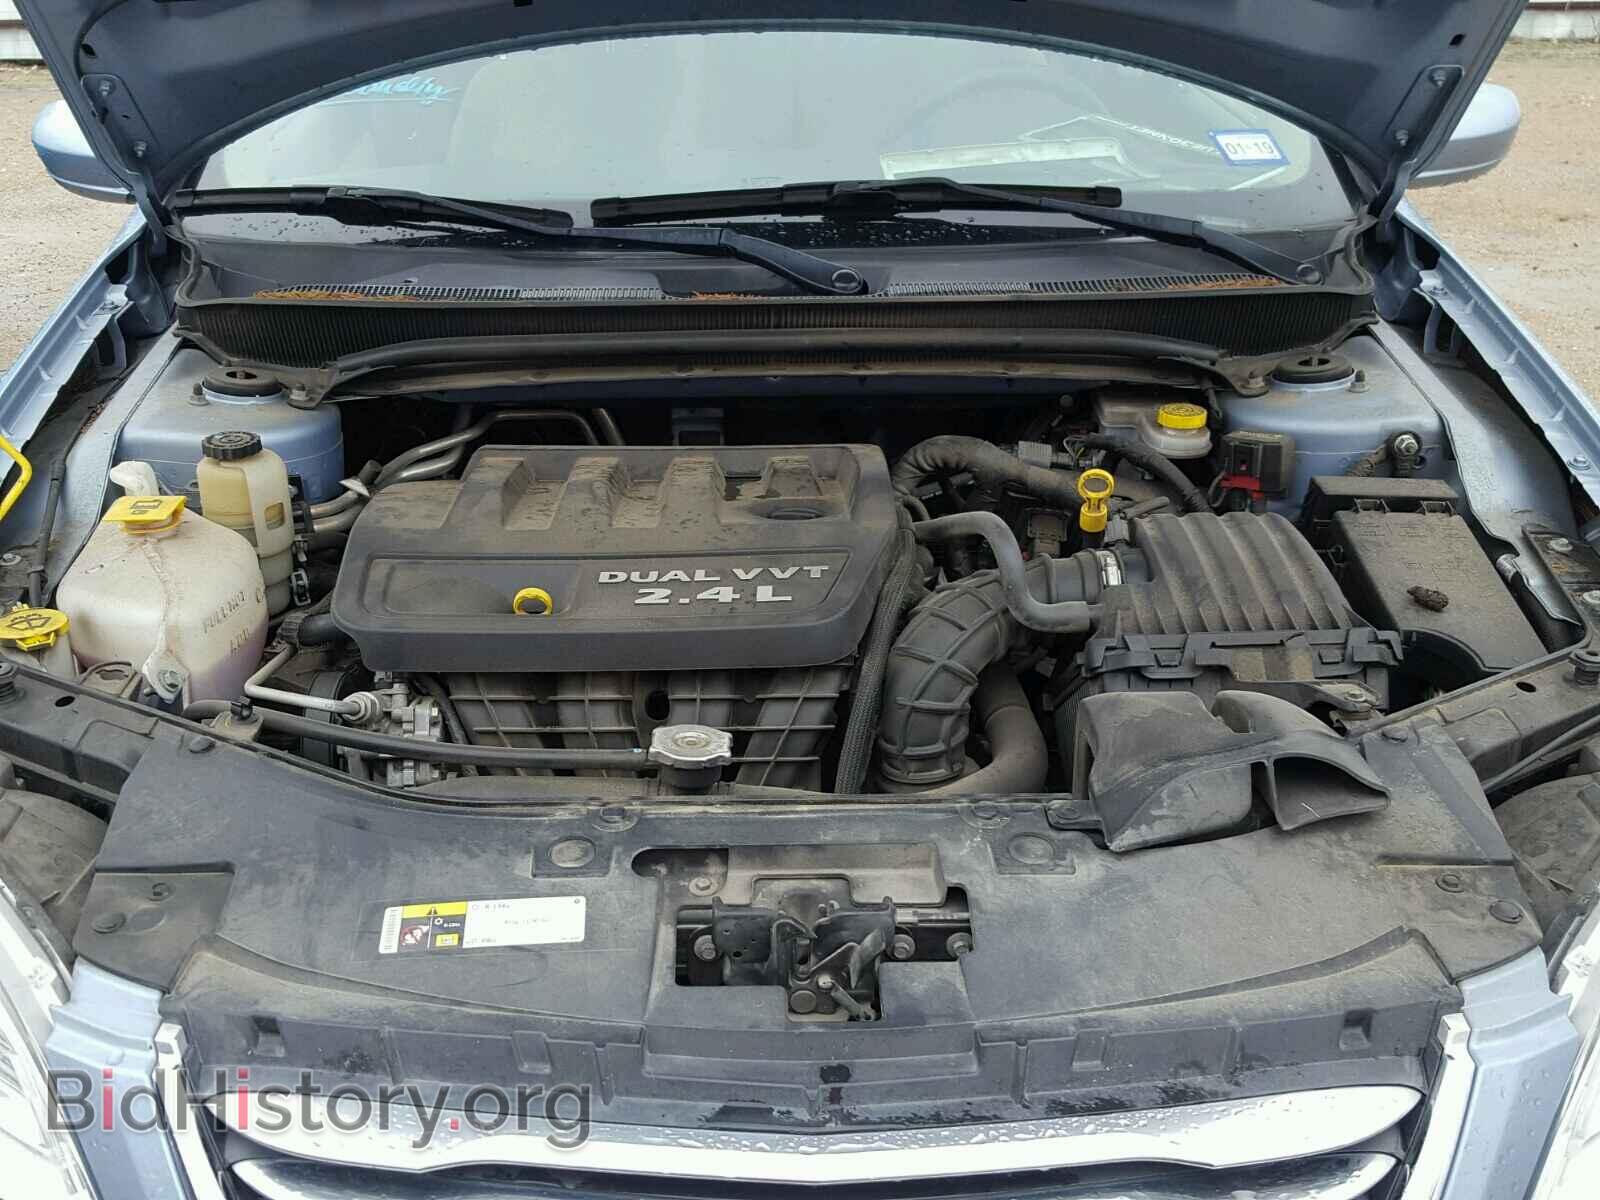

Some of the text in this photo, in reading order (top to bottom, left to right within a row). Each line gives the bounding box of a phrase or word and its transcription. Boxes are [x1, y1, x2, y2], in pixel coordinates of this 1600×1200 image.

[598, 565, 829, 584] DUAL VVT
[634, 585, 793, 605] 2.4L
